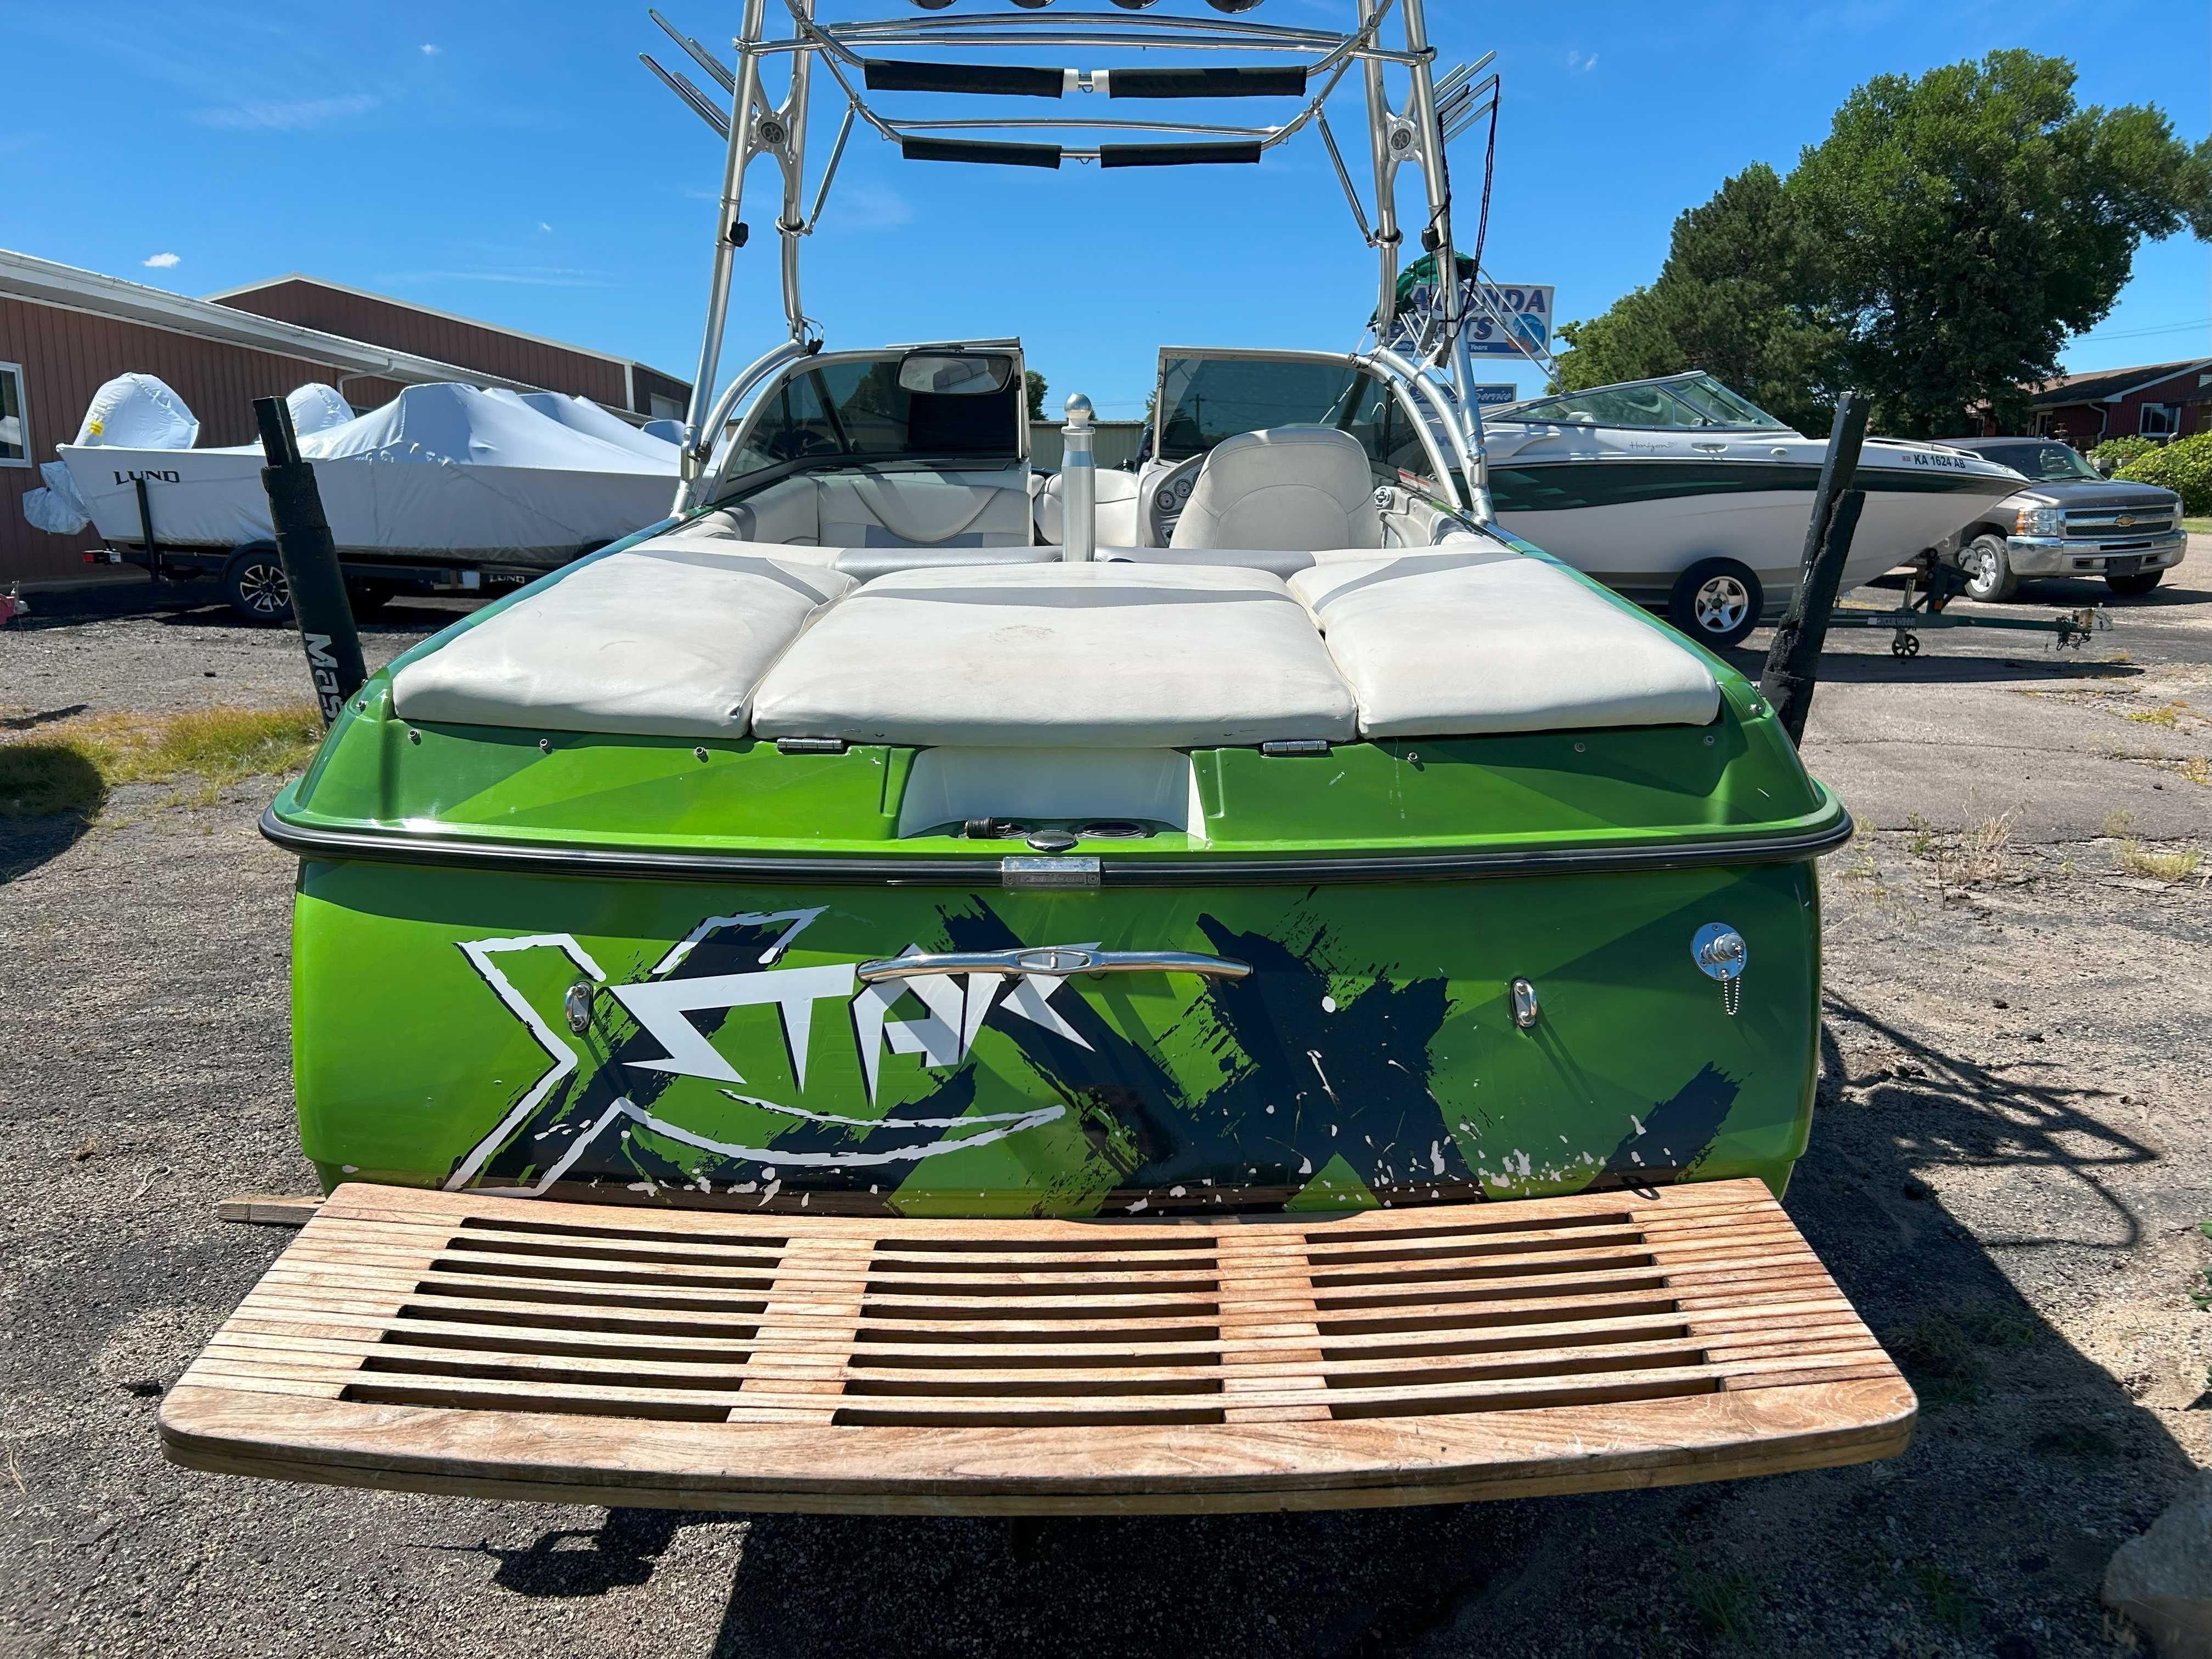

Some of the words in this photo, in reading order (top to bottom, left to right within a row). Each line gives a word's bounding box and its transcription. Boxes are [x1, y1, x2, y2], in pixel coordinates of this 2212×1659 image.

[1914, 454, 1928, 465] KA
[1930, 455, 1952, 466] 1624
[1954, 459, 1966, 469] AB
[113, 471, 180, 486] LUND
[489, 574, 525, 584] LUND
[304, 633, 344, 729] Mas
